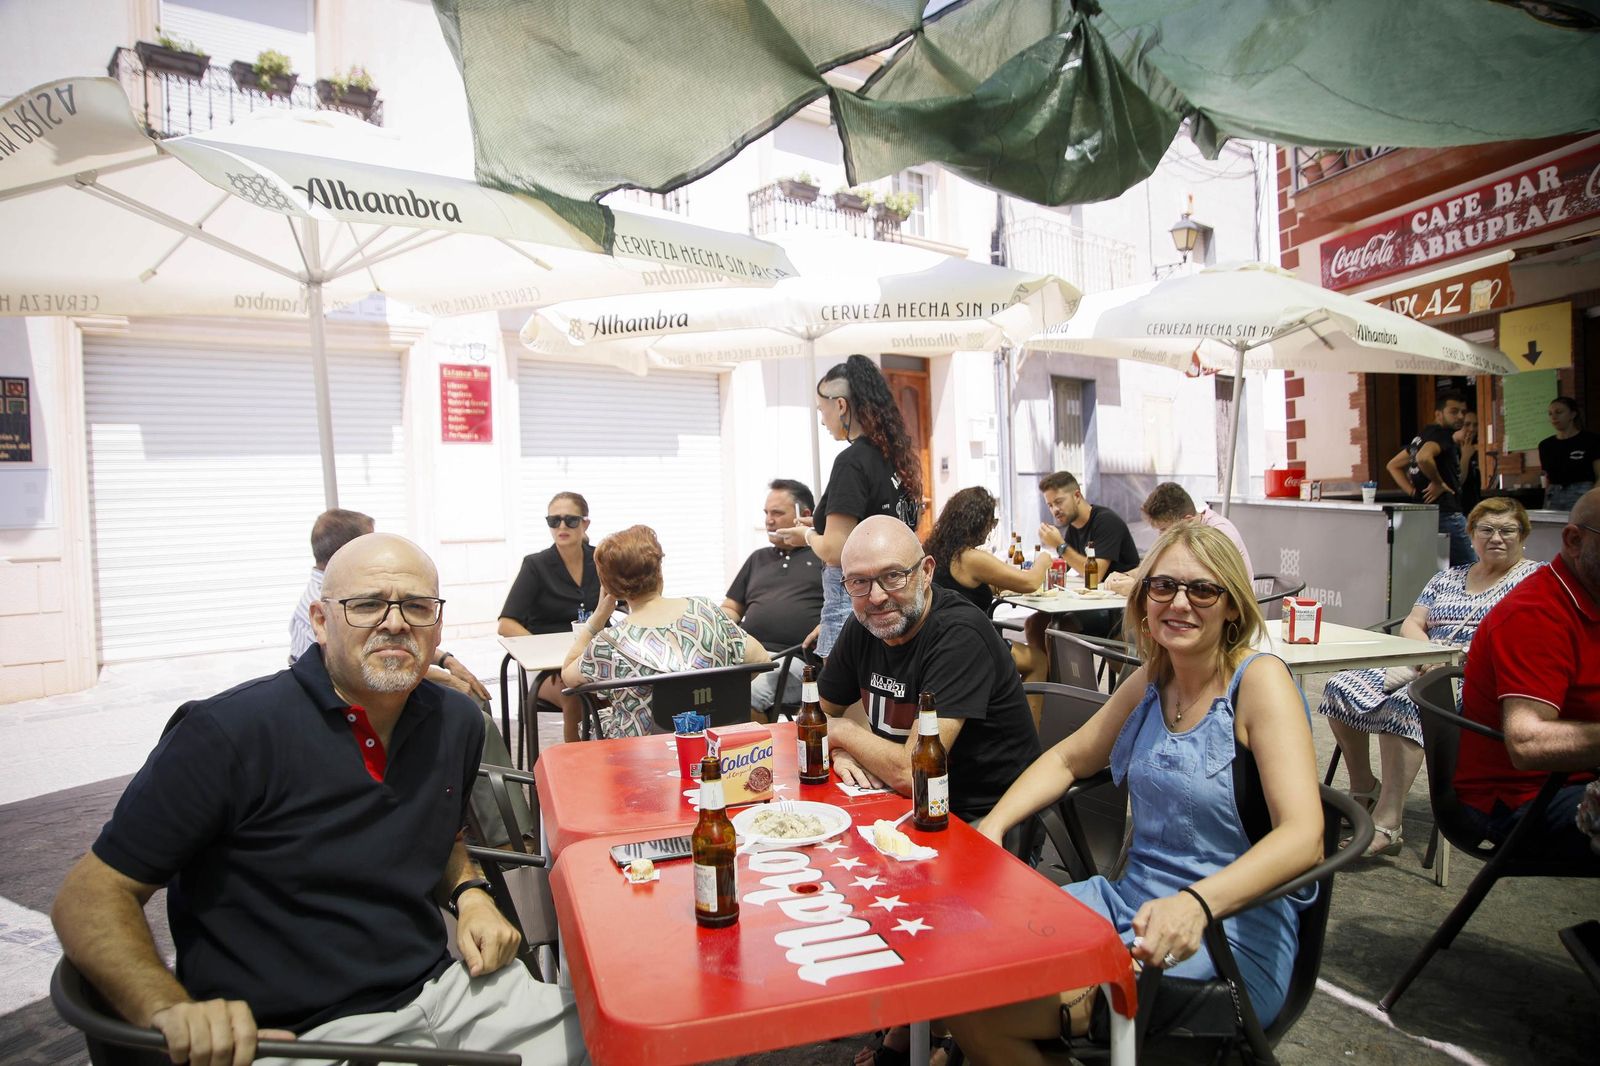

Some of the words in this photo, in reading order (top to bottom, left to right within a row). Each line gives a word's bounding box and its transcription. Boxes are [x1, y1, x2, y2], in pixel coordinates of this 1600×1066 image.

[293, 177, 463, 224] Alhambra
[1411, 192, 1482, 234] CAFE
[1494, 165, 1562, 203] BAR
[1409, 196, 1569, 264] ABRUPLAZ
[614, 233, 679, 261] CERVEZA
[680, 245, 724, 270] HECHA
[726, 255, 748, 276] SIN
[588, 309, 689, 337] Alhambra
[821, 303, 892, 321] CERVEZA
[897, 301, 950, 318] HECHA
[956, 301, 983, 318] SIN
[1146, 322, 1192, 336] CERVEZA
[1195, 323, 1232, 337] HECHA
[1236, 324, 1257, 338] SIN
